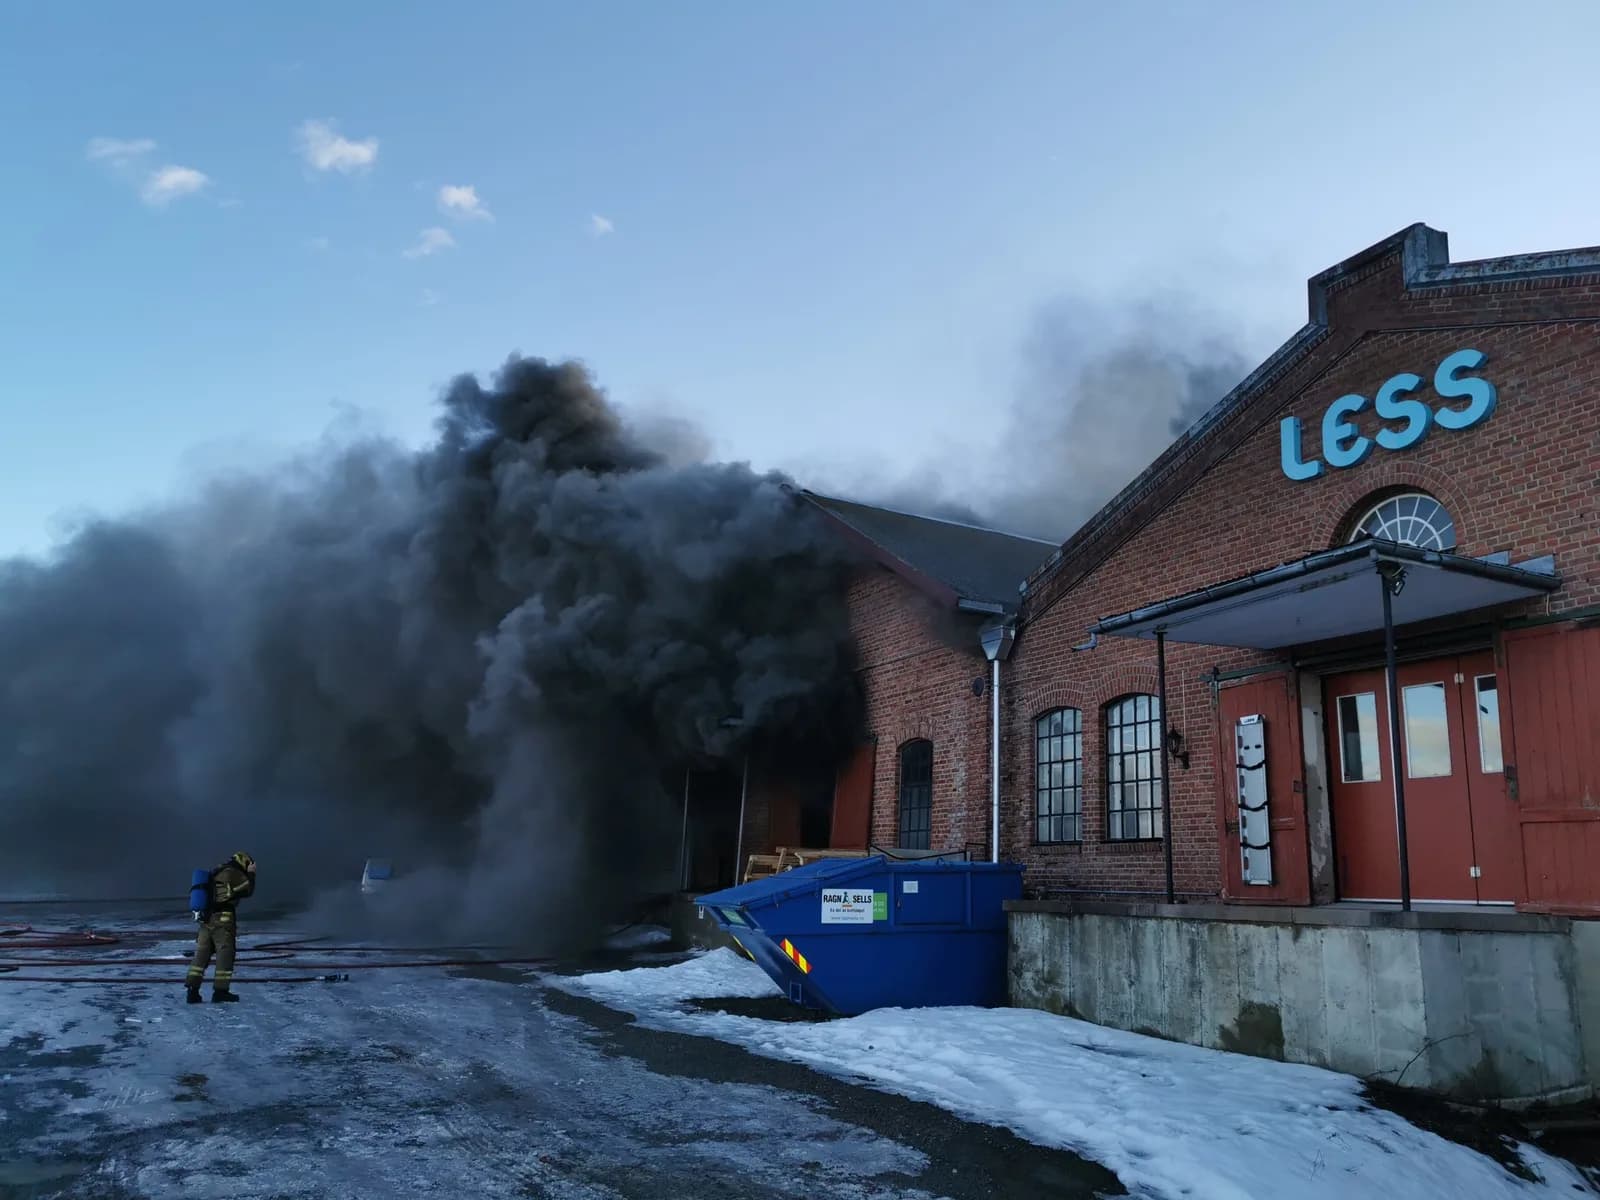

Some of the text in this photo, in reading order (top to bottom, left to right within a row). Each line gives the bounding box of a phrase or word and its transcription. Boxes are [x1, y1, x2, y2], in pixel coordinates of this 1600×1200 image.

[1280, 348, 1497, 481] LESS
[823, 894, 872, 903] RAGN SELLS
